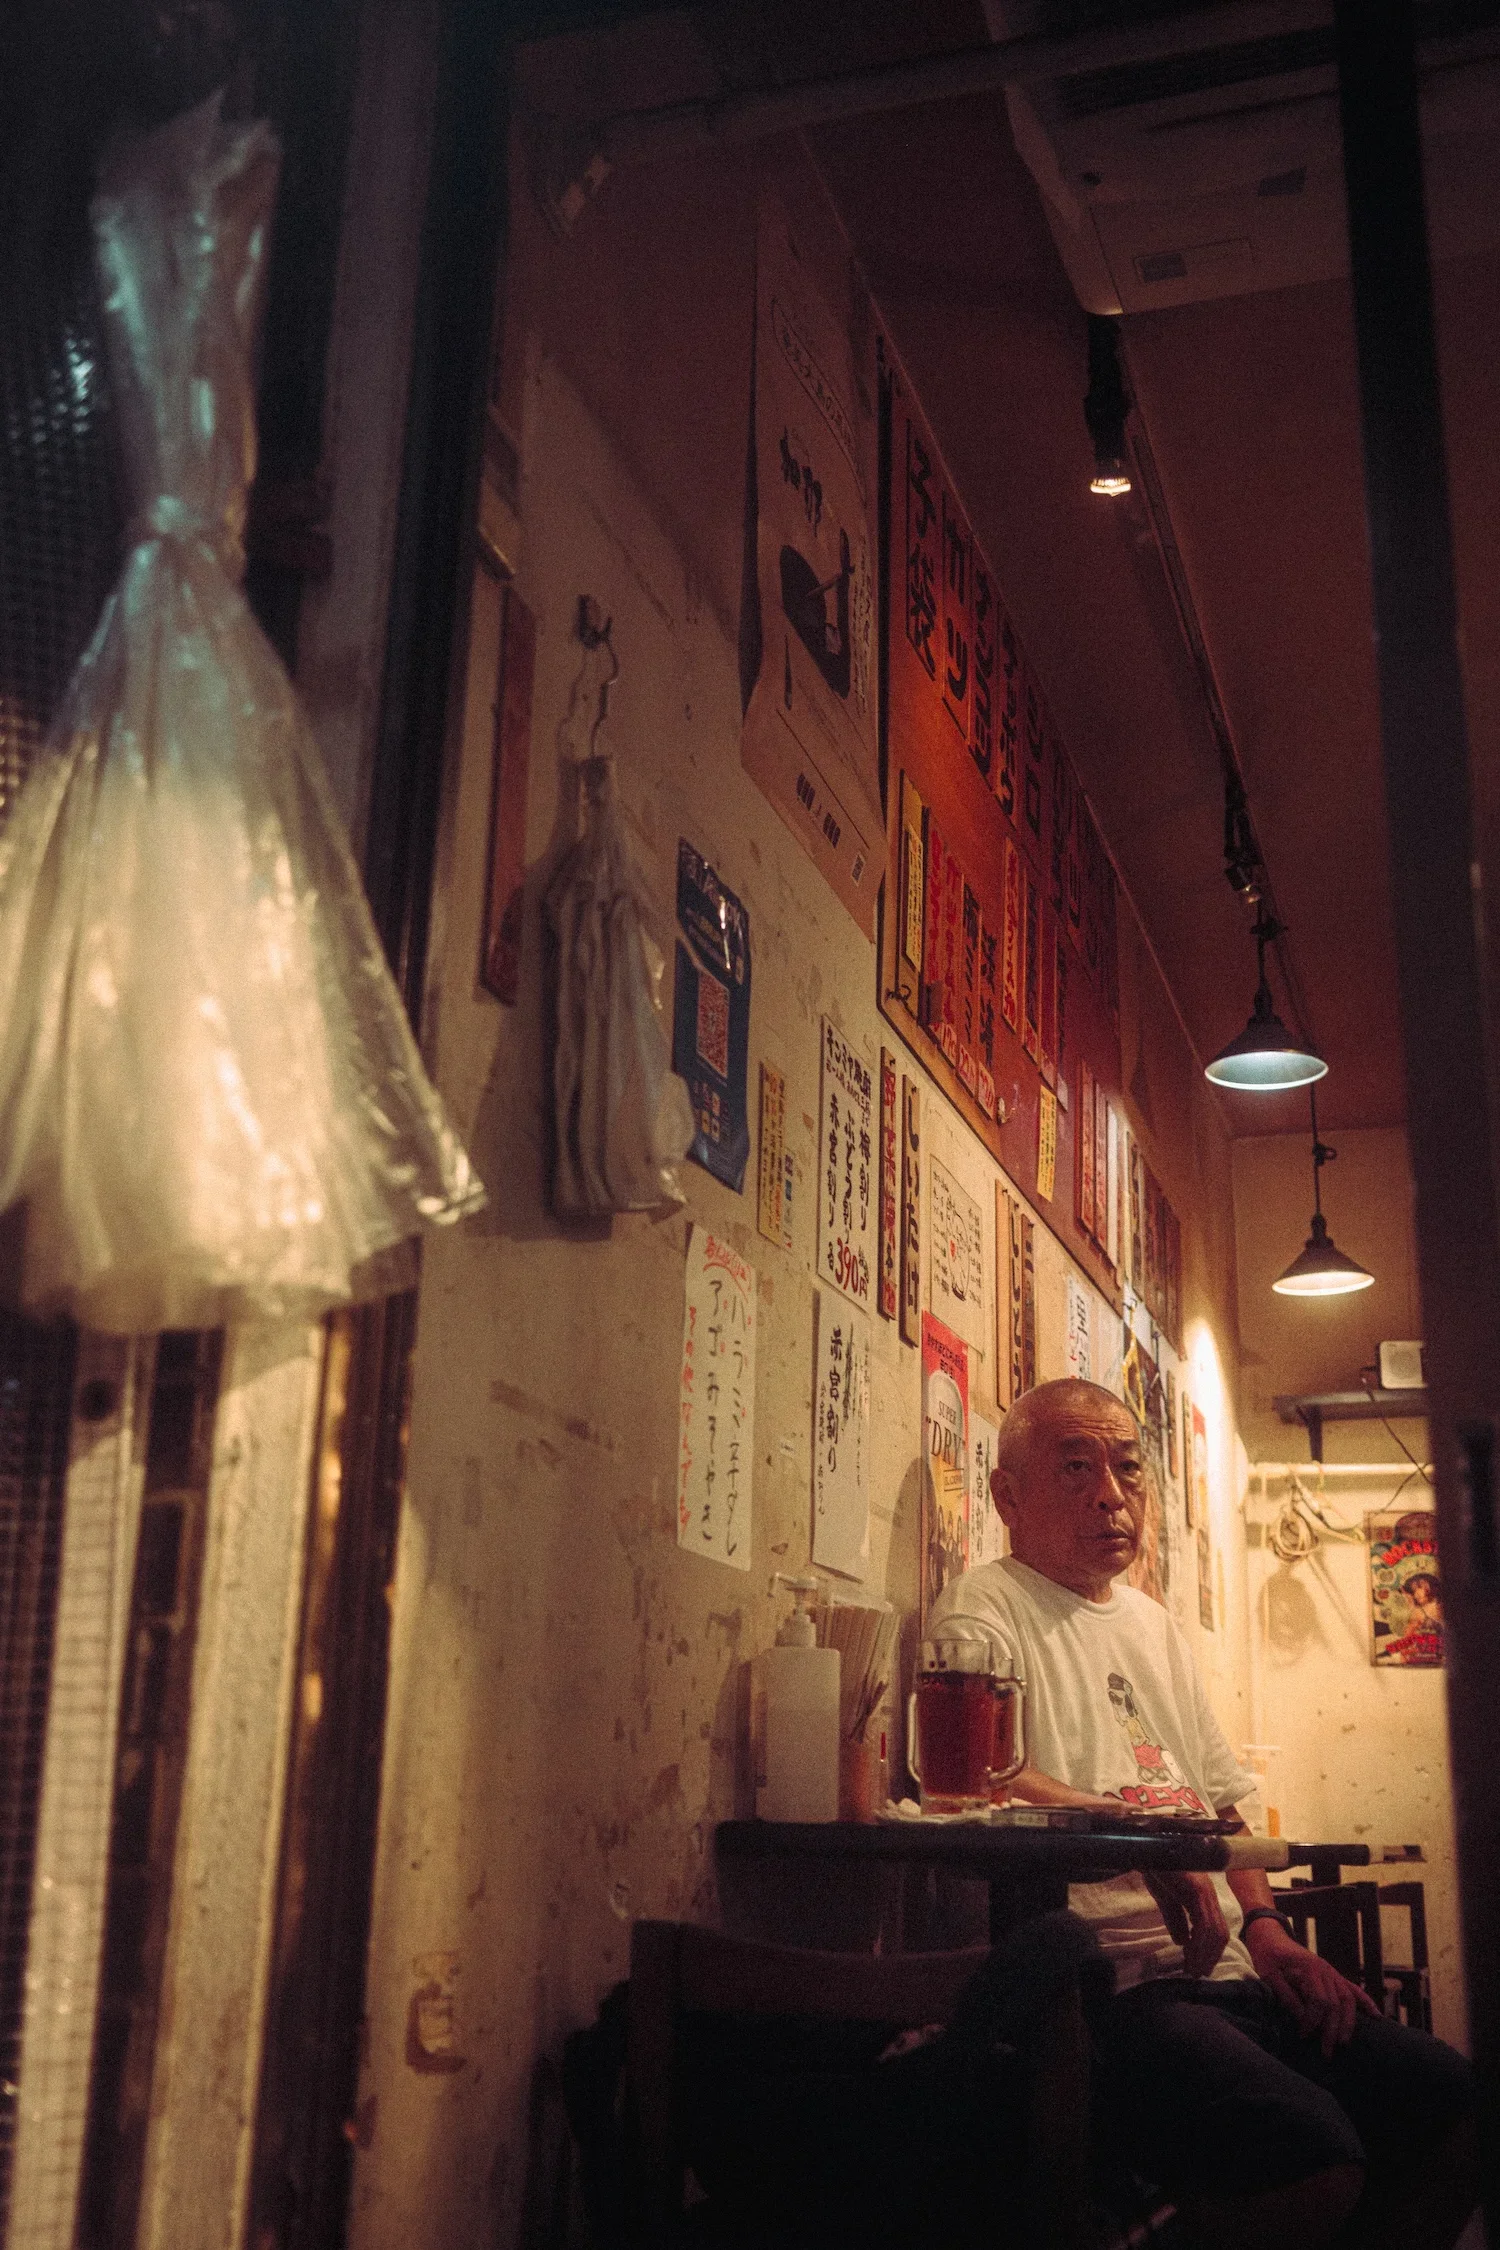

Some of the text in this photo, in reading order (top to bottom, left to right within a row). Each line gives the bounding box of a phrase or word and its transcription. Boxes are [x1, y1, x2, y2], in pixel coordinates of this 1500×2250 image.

[907, 1095, 919, 1316] しいたけ
[1011, 1212, 1021, 1399] ししとう
[939, 1401, 957, 1426] SUPER
